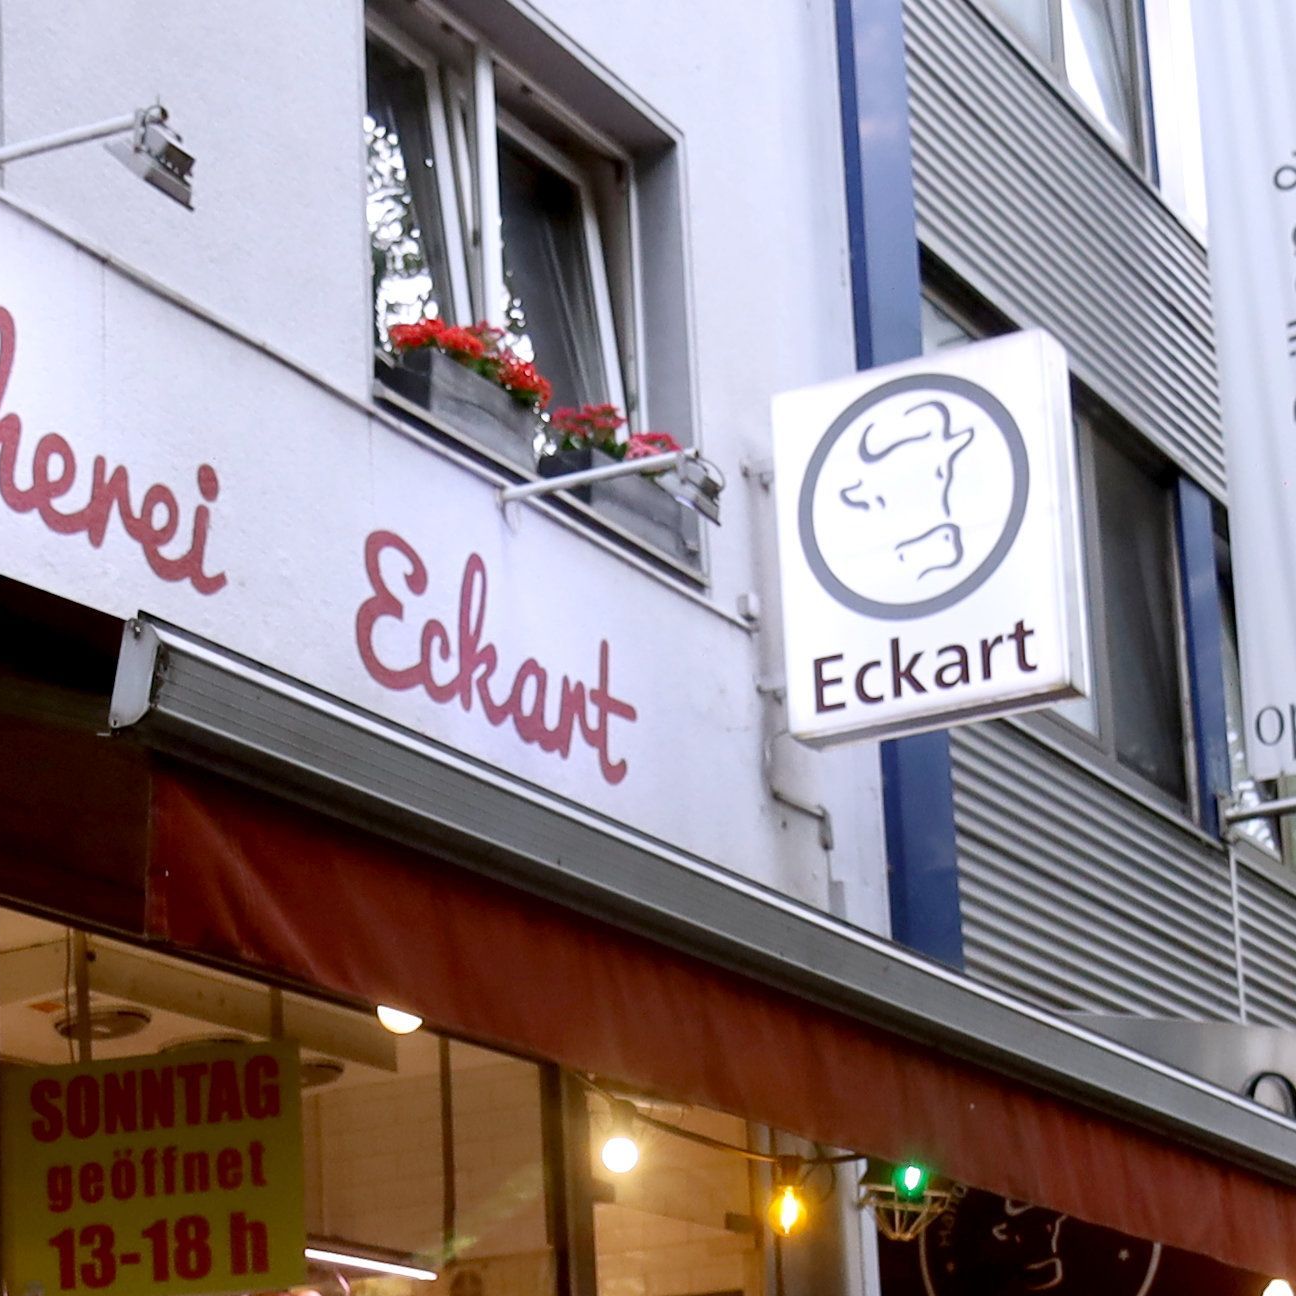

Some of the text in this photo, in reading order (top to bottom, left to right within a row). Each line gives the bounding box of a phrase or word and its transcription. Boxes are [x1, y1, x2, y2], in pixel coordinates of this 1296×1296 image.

[355, 530, 638, 785] Eckart
[811, 618, 1039, 717] Eckart
[29, 1054, 282, 1144] SONNTAG
[46, 1140, 268, 1214] geöffnet
[49, 1210, 271, 1291] 13-18 h
